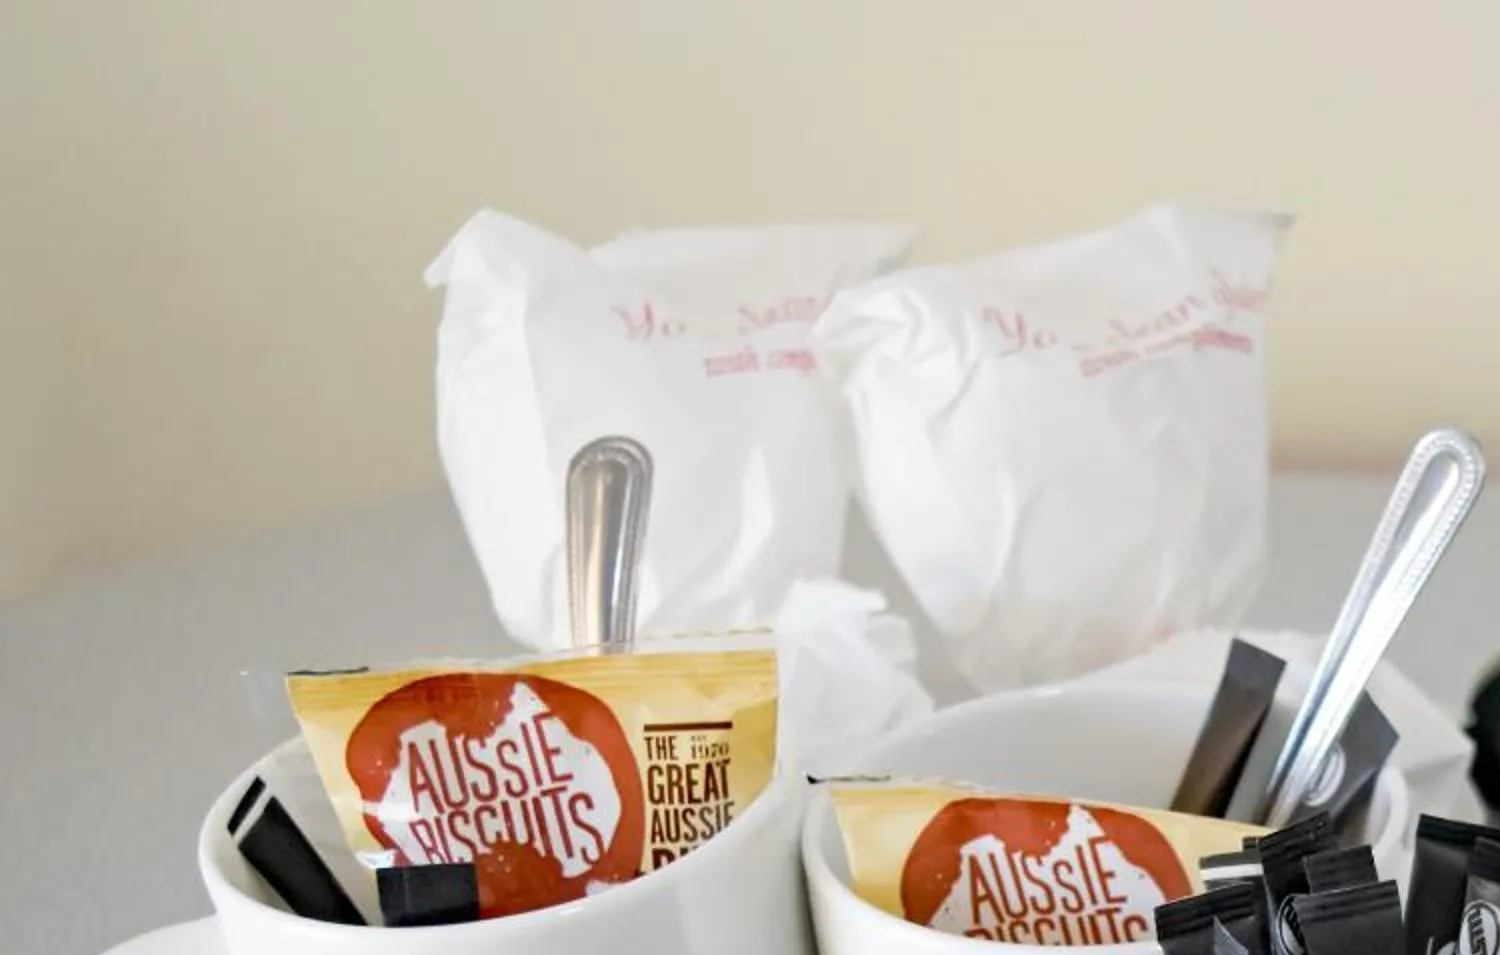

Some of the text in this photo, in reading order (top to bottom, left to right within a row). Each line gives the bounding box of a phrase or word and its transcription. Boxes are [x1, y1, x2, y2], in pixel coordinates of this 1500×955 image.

[409, 712, 574, 814] AUSSIE
[644, 736, 678, 761] THE
[647, 759, 732, 805] GREAT
[409, 785, 606, 865] BISCUITS
[651, 801, 736, 845] AUSSIE
[968, 835, 1128, 926] AUSSIE
